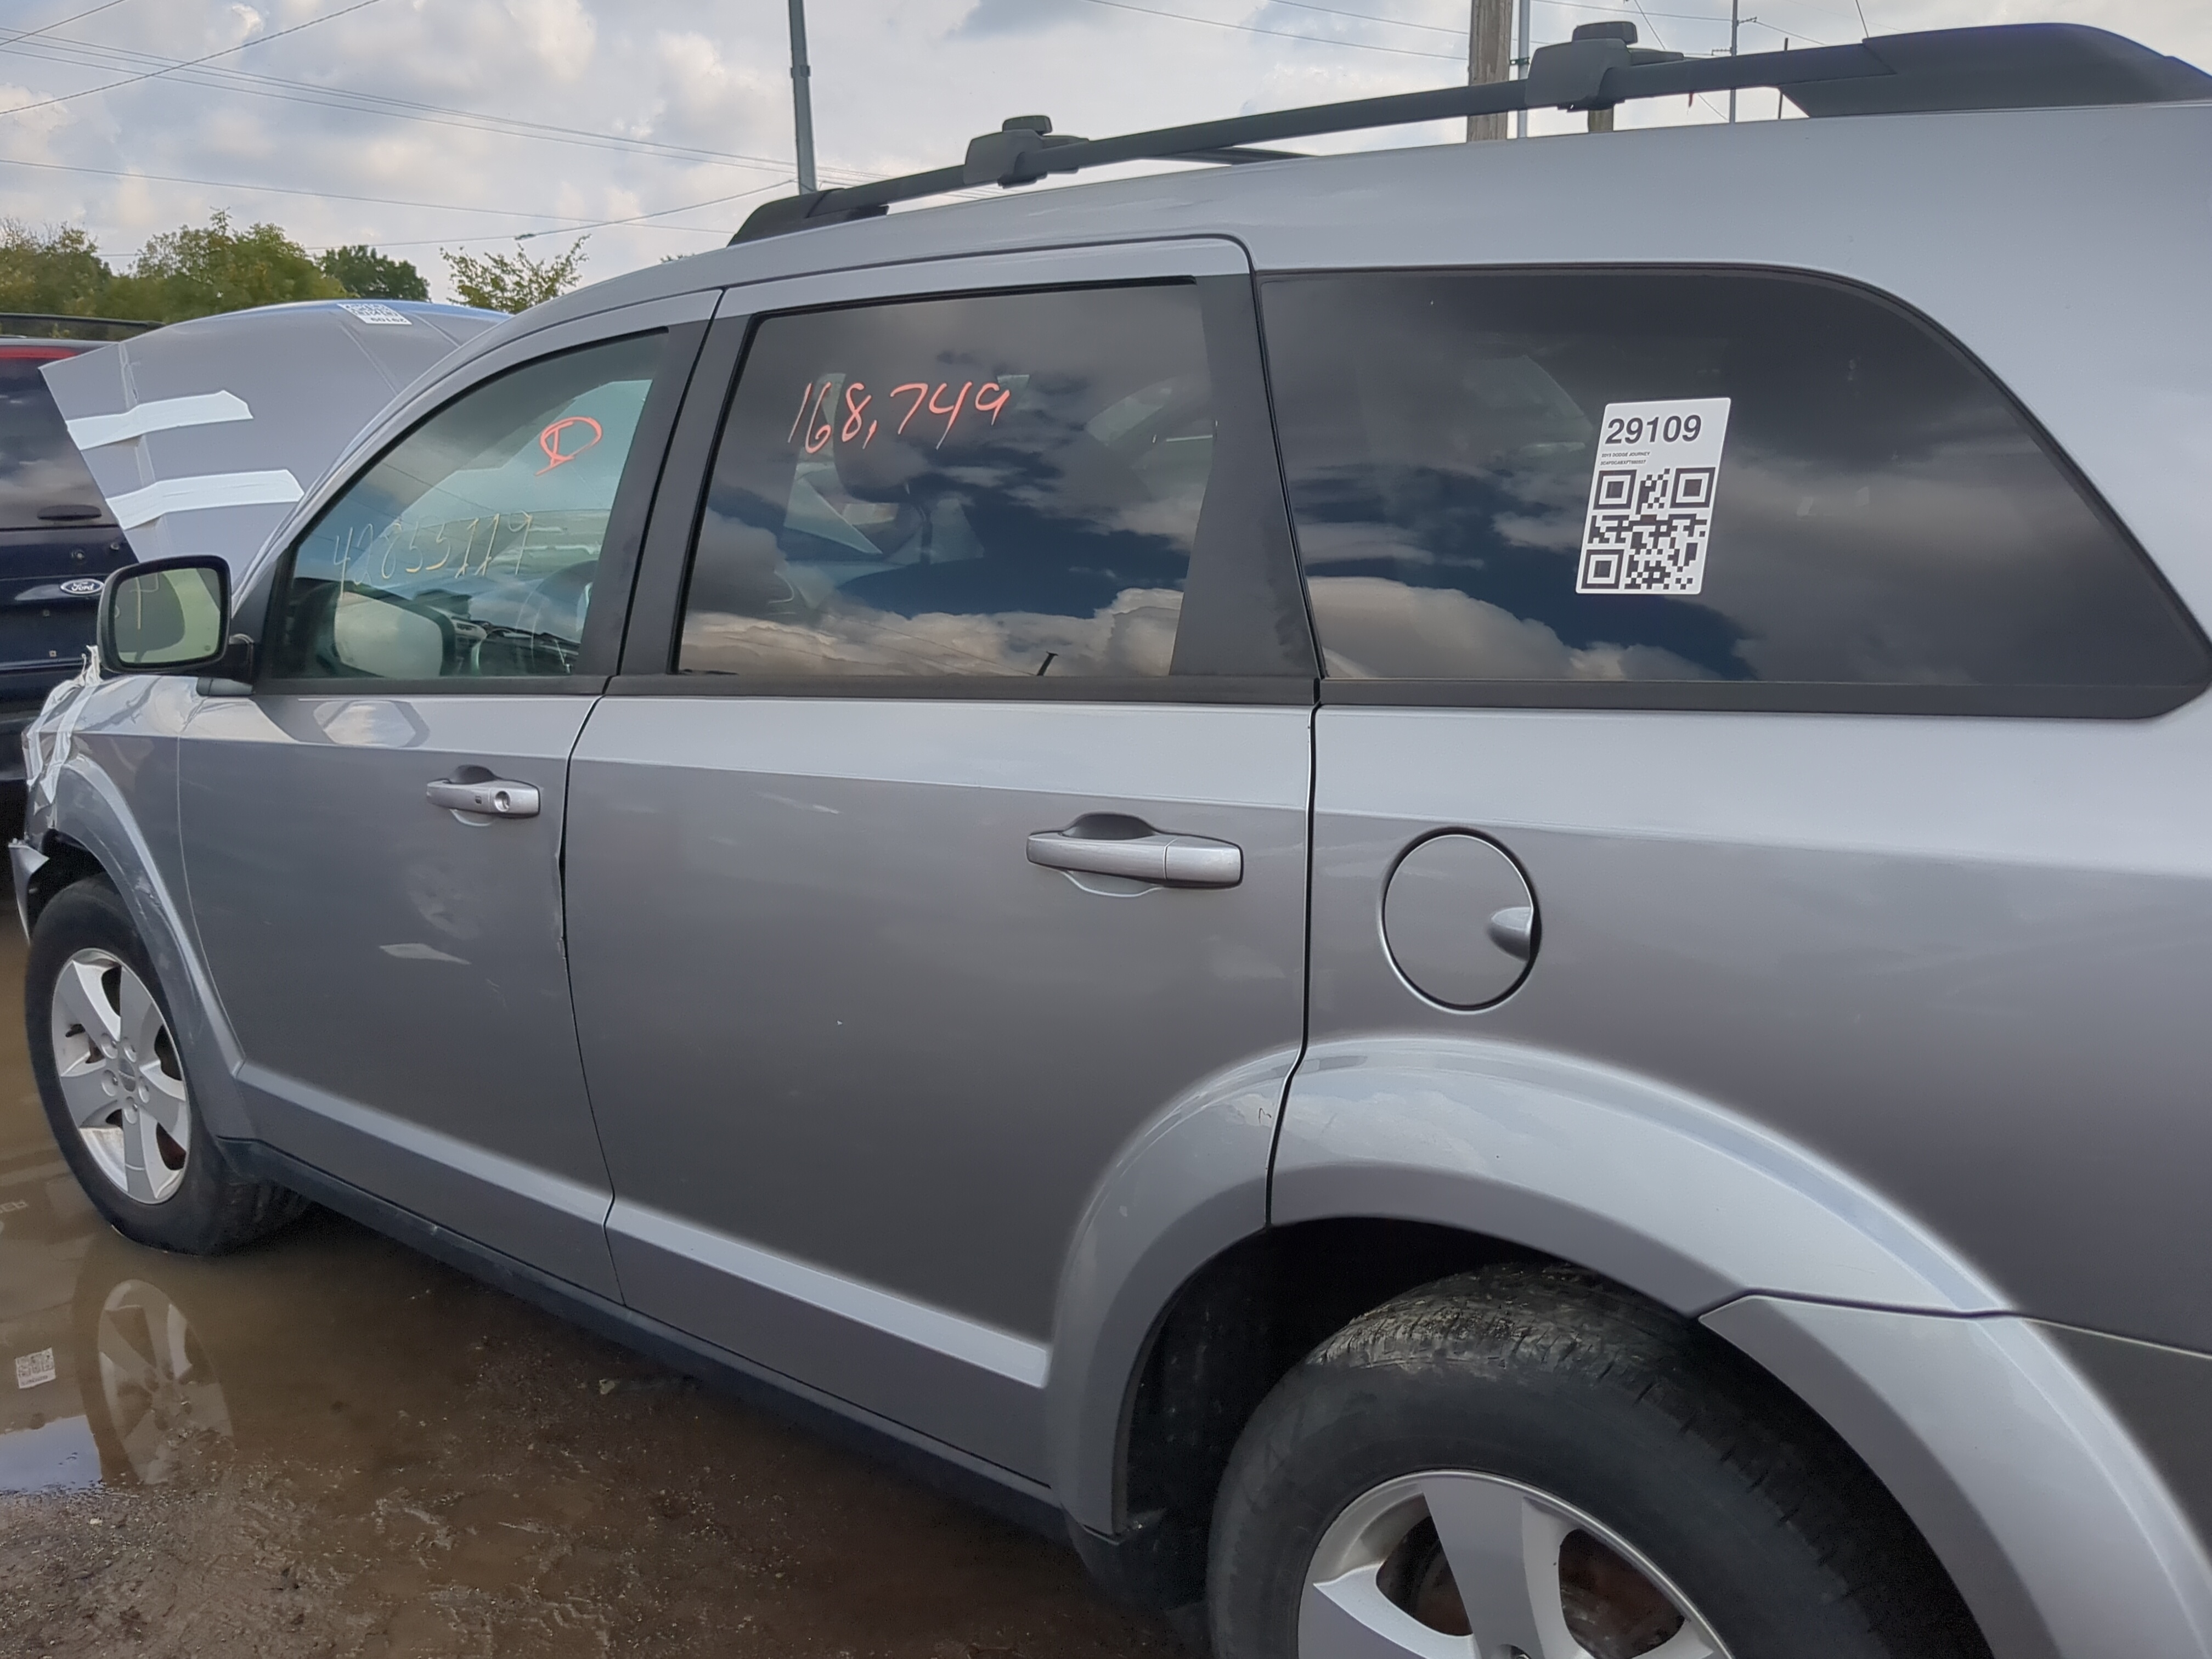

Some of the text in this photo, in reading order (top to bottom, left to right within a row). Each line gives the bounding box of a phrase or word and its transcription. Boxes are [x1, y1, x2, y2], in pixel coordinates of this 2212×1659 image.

[787, 381, 1011, 454] 168,749
[1605, 414, 1702, 445] 29109
[71, 582, 94, 591] Ford
